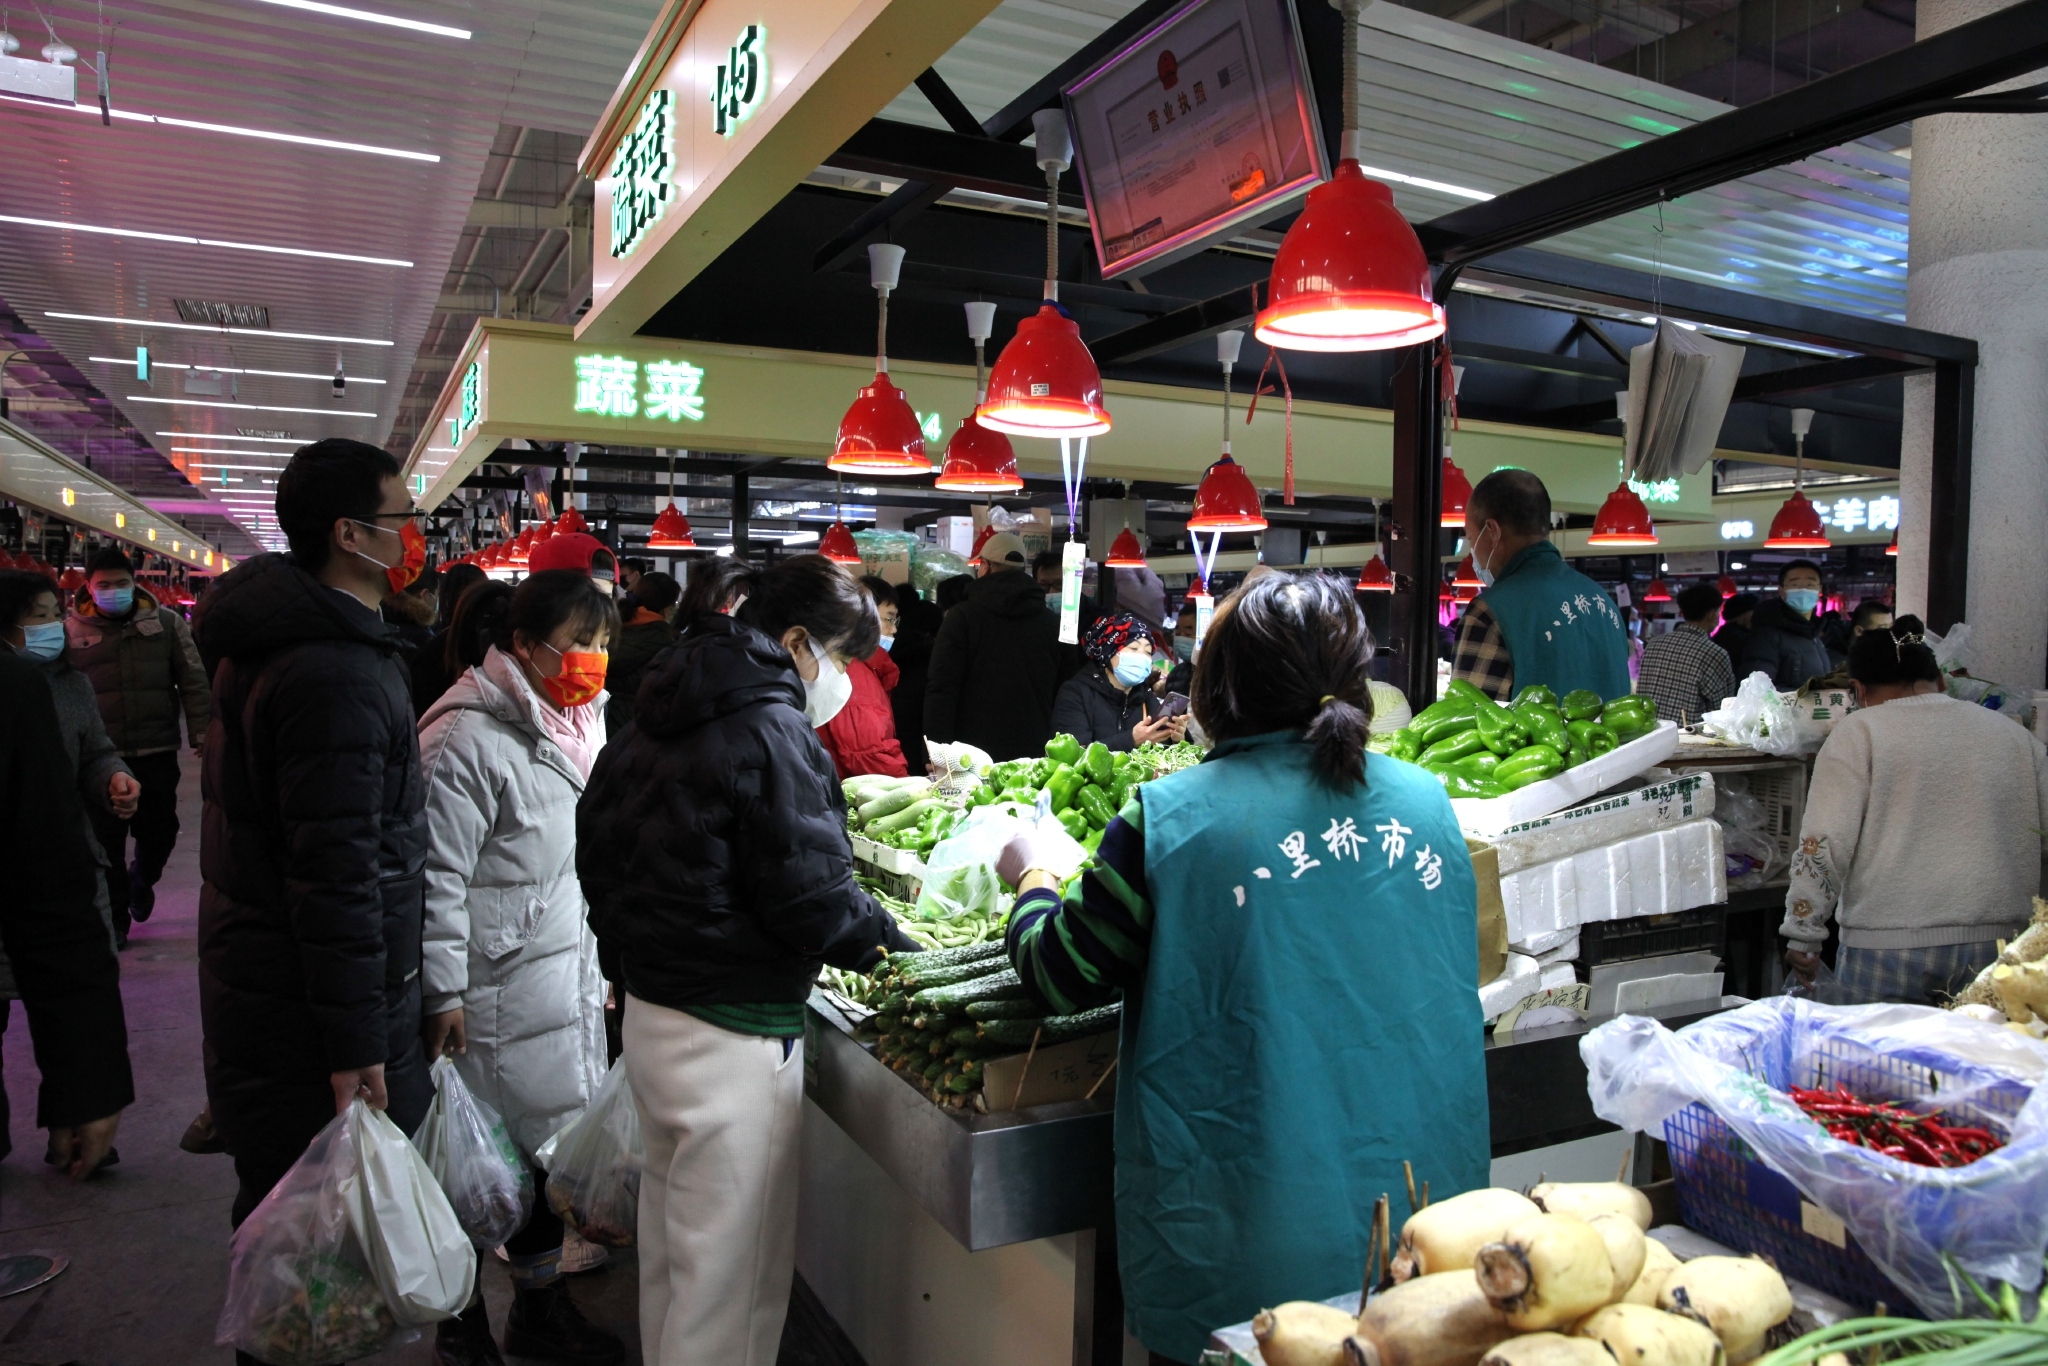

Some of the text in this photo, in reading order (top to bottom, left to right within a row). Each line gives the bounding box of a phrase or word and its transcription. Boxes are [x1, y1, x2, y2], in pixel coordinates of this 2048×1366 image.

[709, 24, 766, 136] 145
[1147, 80, 1207, 134] 营业执照
[611, 89, 674, 258] 蔬菜
[575, 354, 704, 420] 蔬菜
[1106, 631, 1120, 645] LOVE
[1232, 817, 1442, 907] 八里桥市场
